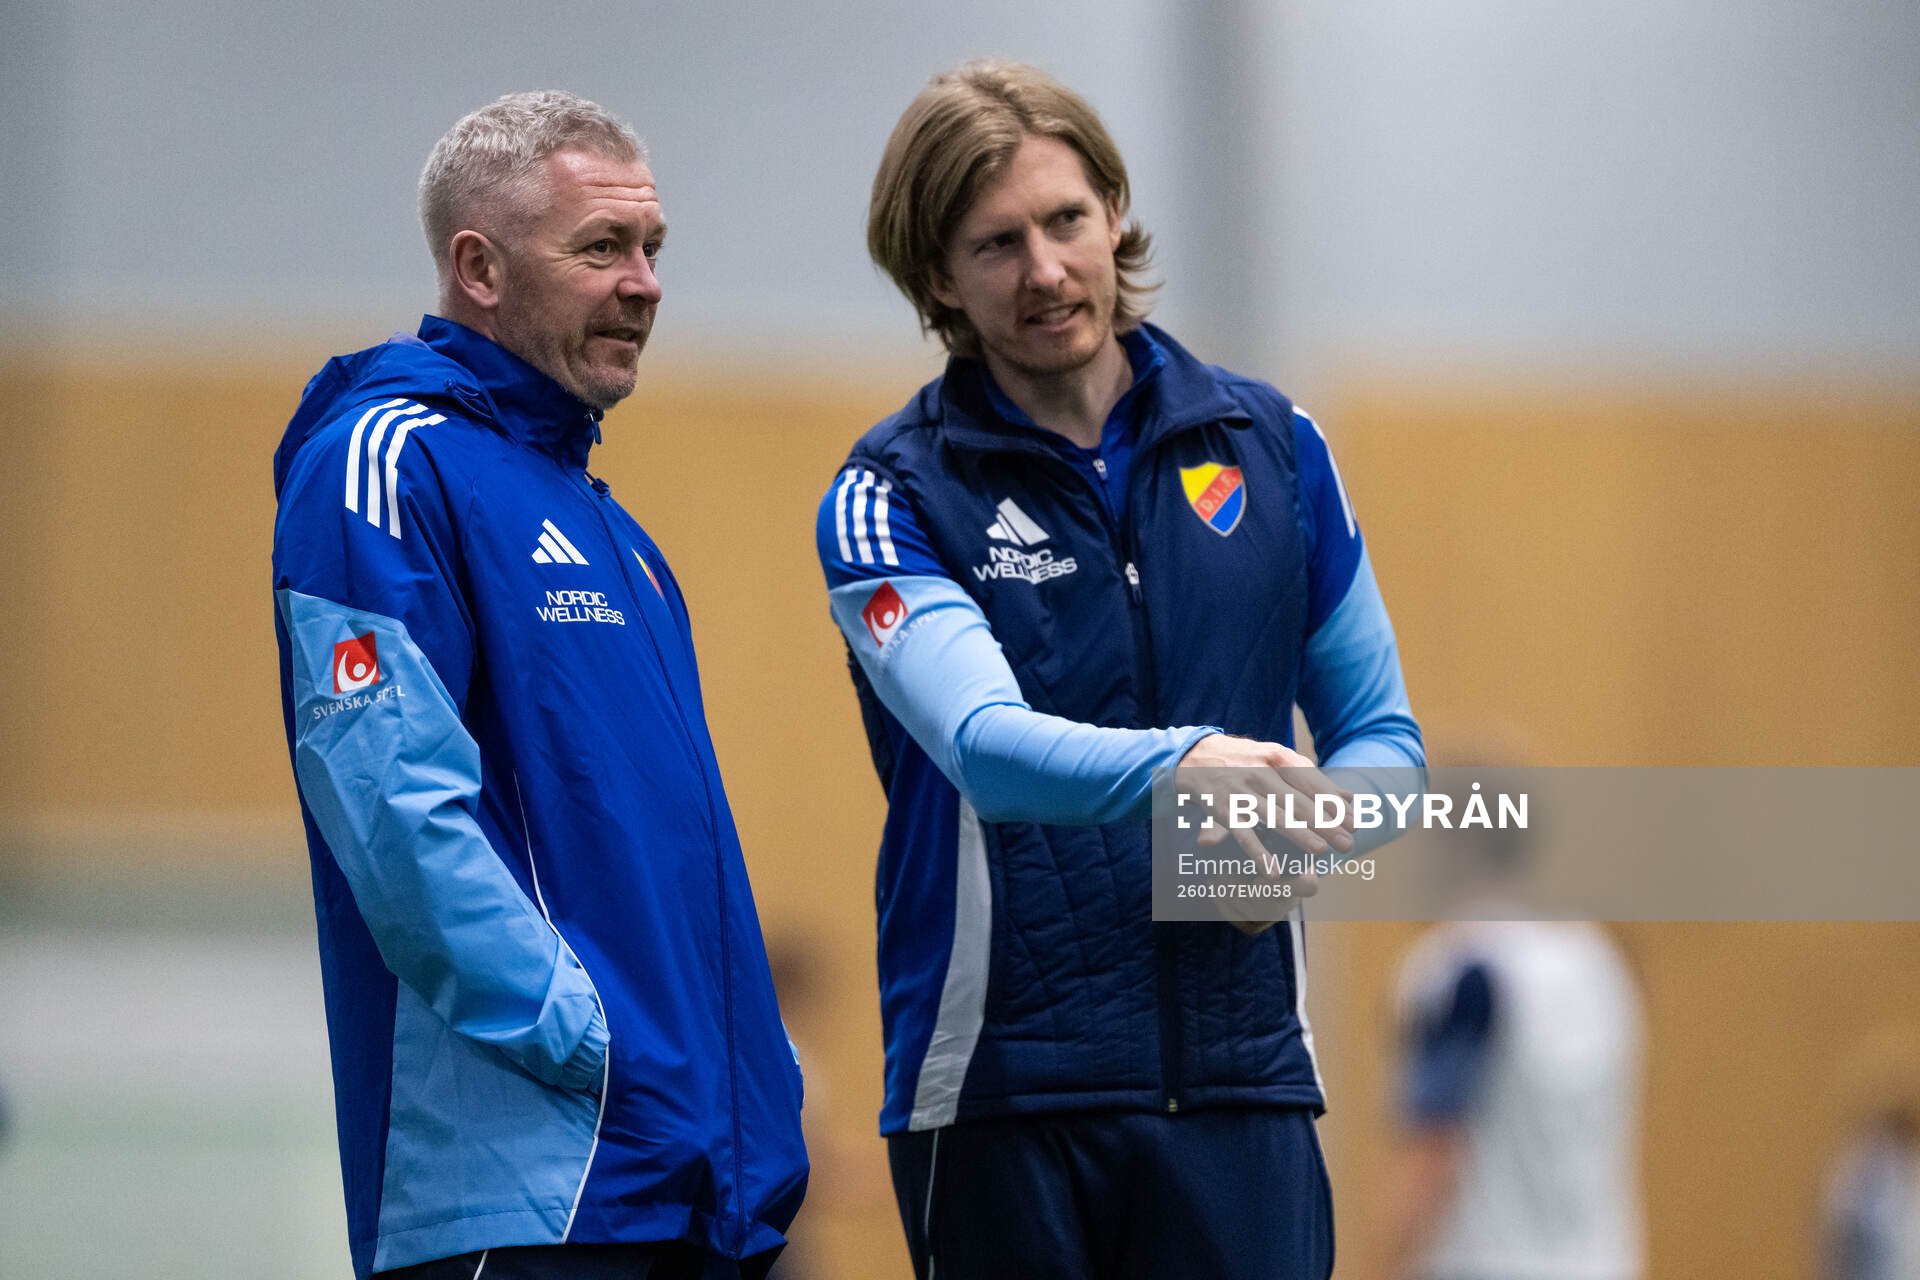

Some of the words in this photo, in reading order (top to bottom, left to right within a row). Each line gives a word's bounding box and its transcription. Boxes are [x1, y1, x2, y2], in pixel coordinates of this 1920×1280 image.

[545, 590, 608, 607] NORDIC
[535, 606, 626, 626] WELLNESS
[313, 694, 373, 720] SVENSKA
